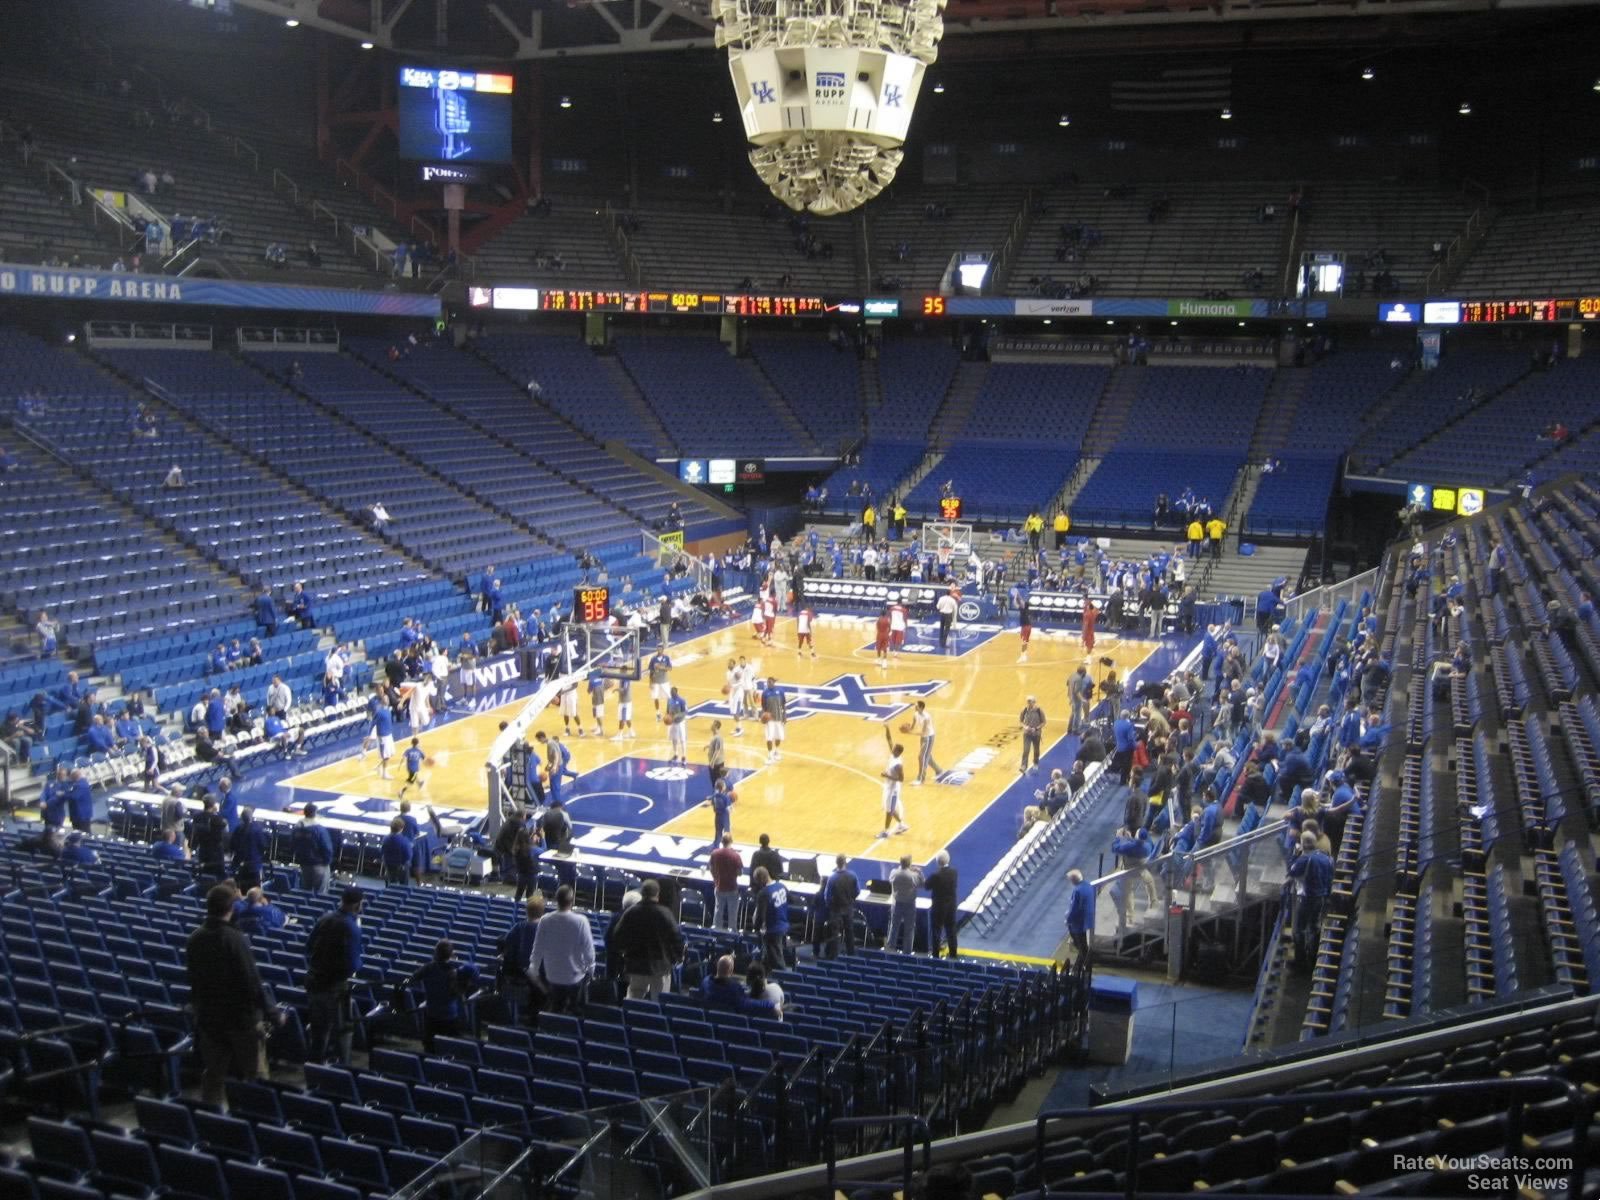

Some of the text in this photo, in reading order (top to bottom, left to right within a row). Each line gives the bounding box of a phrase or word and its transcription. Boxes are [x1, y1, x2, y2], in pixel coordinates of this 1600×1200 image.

[751, 81, 775, 104] UK
[815, 89, 845, 98] RUPP
[884, 83, 903, 107] UK
[32, 274, 97, 295] RUPP
[110, 280, 181, 300] ARENA
[921, 297, 943, 314] 35
[1050, 304, 1080, 313] verizon
[1180, 302, 1236, 315] Humana
[581, 589, 607, 602] 60:00
